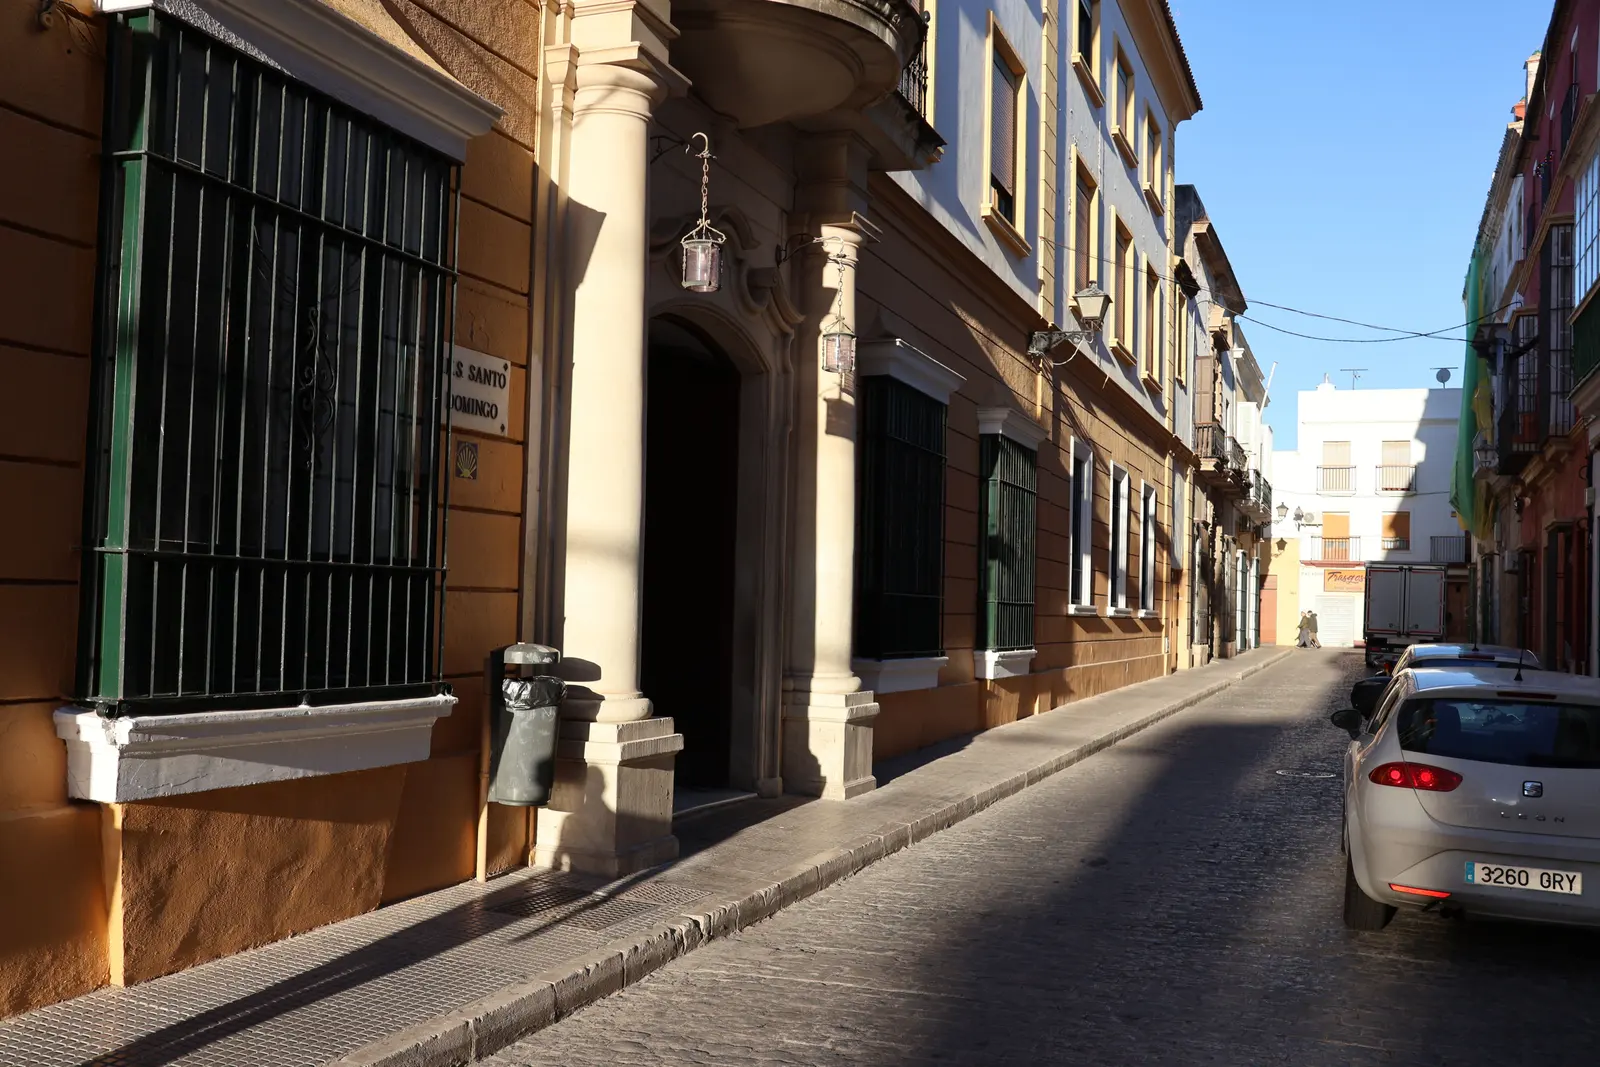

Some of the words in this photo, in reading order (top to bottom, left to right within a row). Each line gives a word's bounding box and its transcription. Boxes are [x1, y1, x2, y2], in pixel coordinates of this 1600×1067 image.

[468, 364, 507, 389] SANTO
[1500, 811, 1565, 823] LEON
[1481, 866, 1530, 886] 3260
[1539, 872, 1577, 891] GRY
